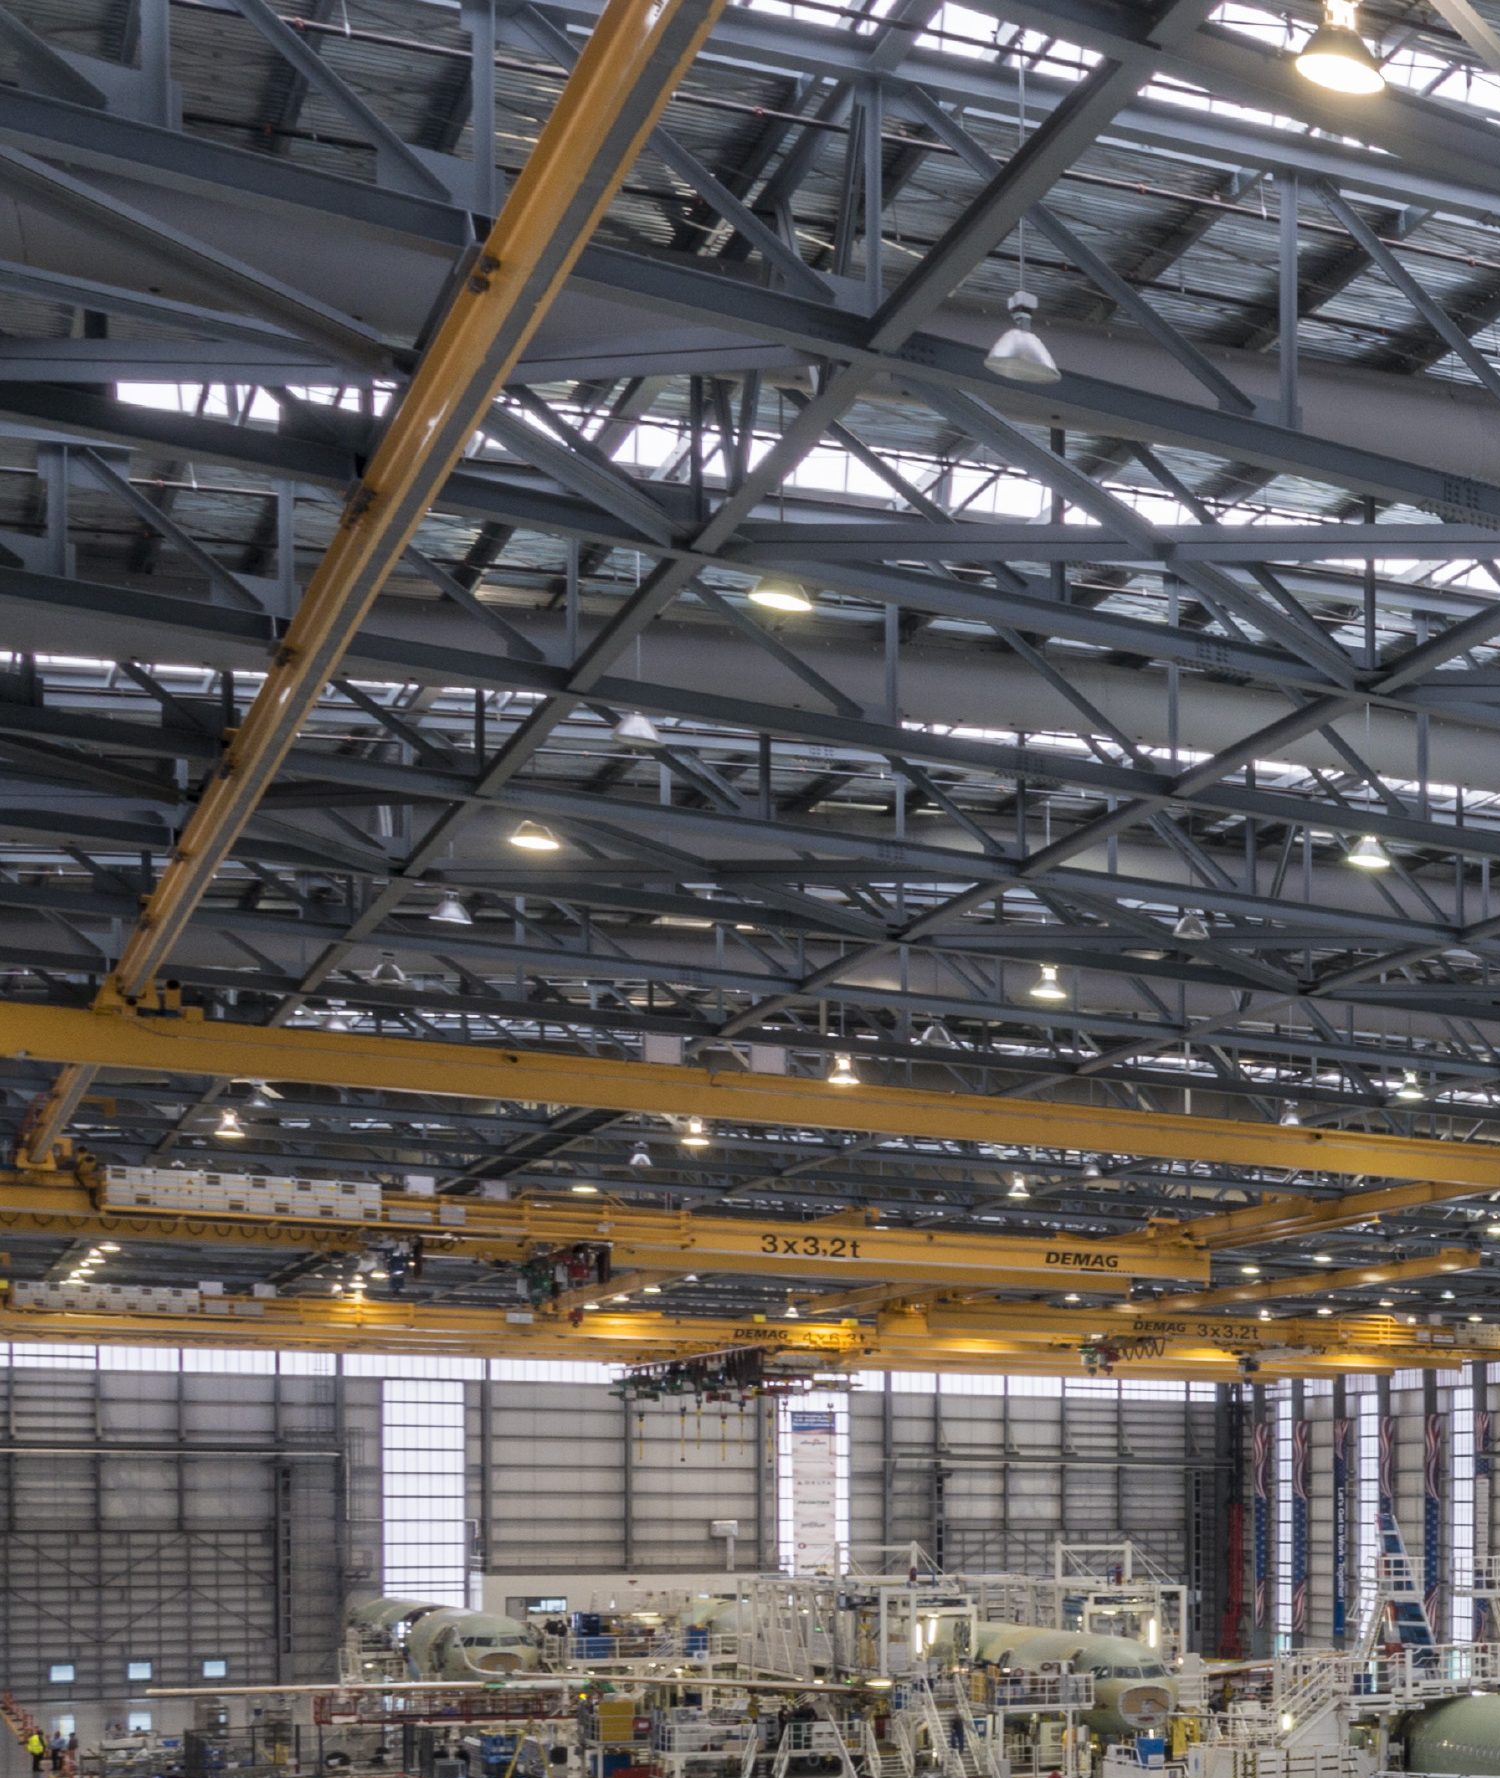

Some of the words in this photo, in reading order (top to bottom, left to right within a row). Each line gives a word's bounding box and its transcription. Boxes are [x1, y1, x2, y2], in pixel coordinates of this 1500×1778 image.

[1045, 1251, 1118, 1269] DEMAG
[1133, 1320, 1186, 1333] DEMAG
[734, 1328, 788, 1341] DEMAG
